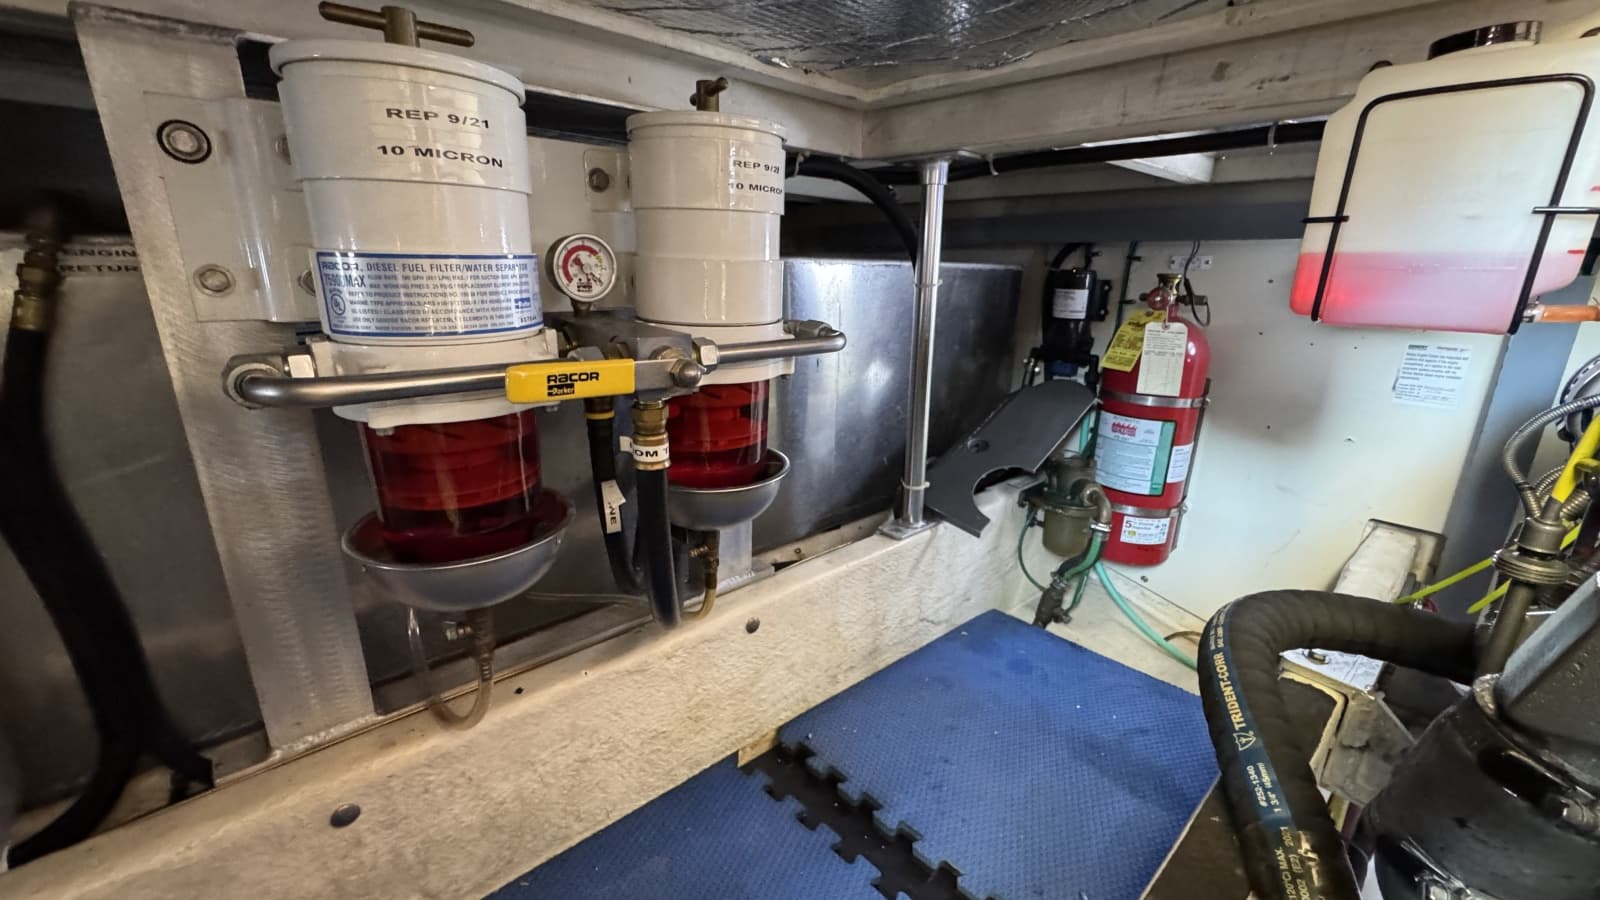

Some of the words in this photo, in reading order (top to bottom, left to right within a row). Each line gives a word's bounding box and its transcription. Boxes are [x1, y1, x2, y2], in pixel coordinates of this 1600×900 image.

[386, 108, 438, 120] REP
[448, 114, 489, 129] 9/21
[378, 145, 405, 156] 10
[414, 147, 502, 168] MICRON
[733, 159, 760, 169] REP
[749, 183, 782, 195] MICRO
[61, 249, 138, 258] ENGIN
[59, 264, 139, 273] RETUR
[367, 263, 397, 271] DIESEL
[402, 263, 426, 272] FUEL
[430, 264, 493, 272] FILTER/WATER
[1213, 652, 1246, 731] TRIDENT-CORR
